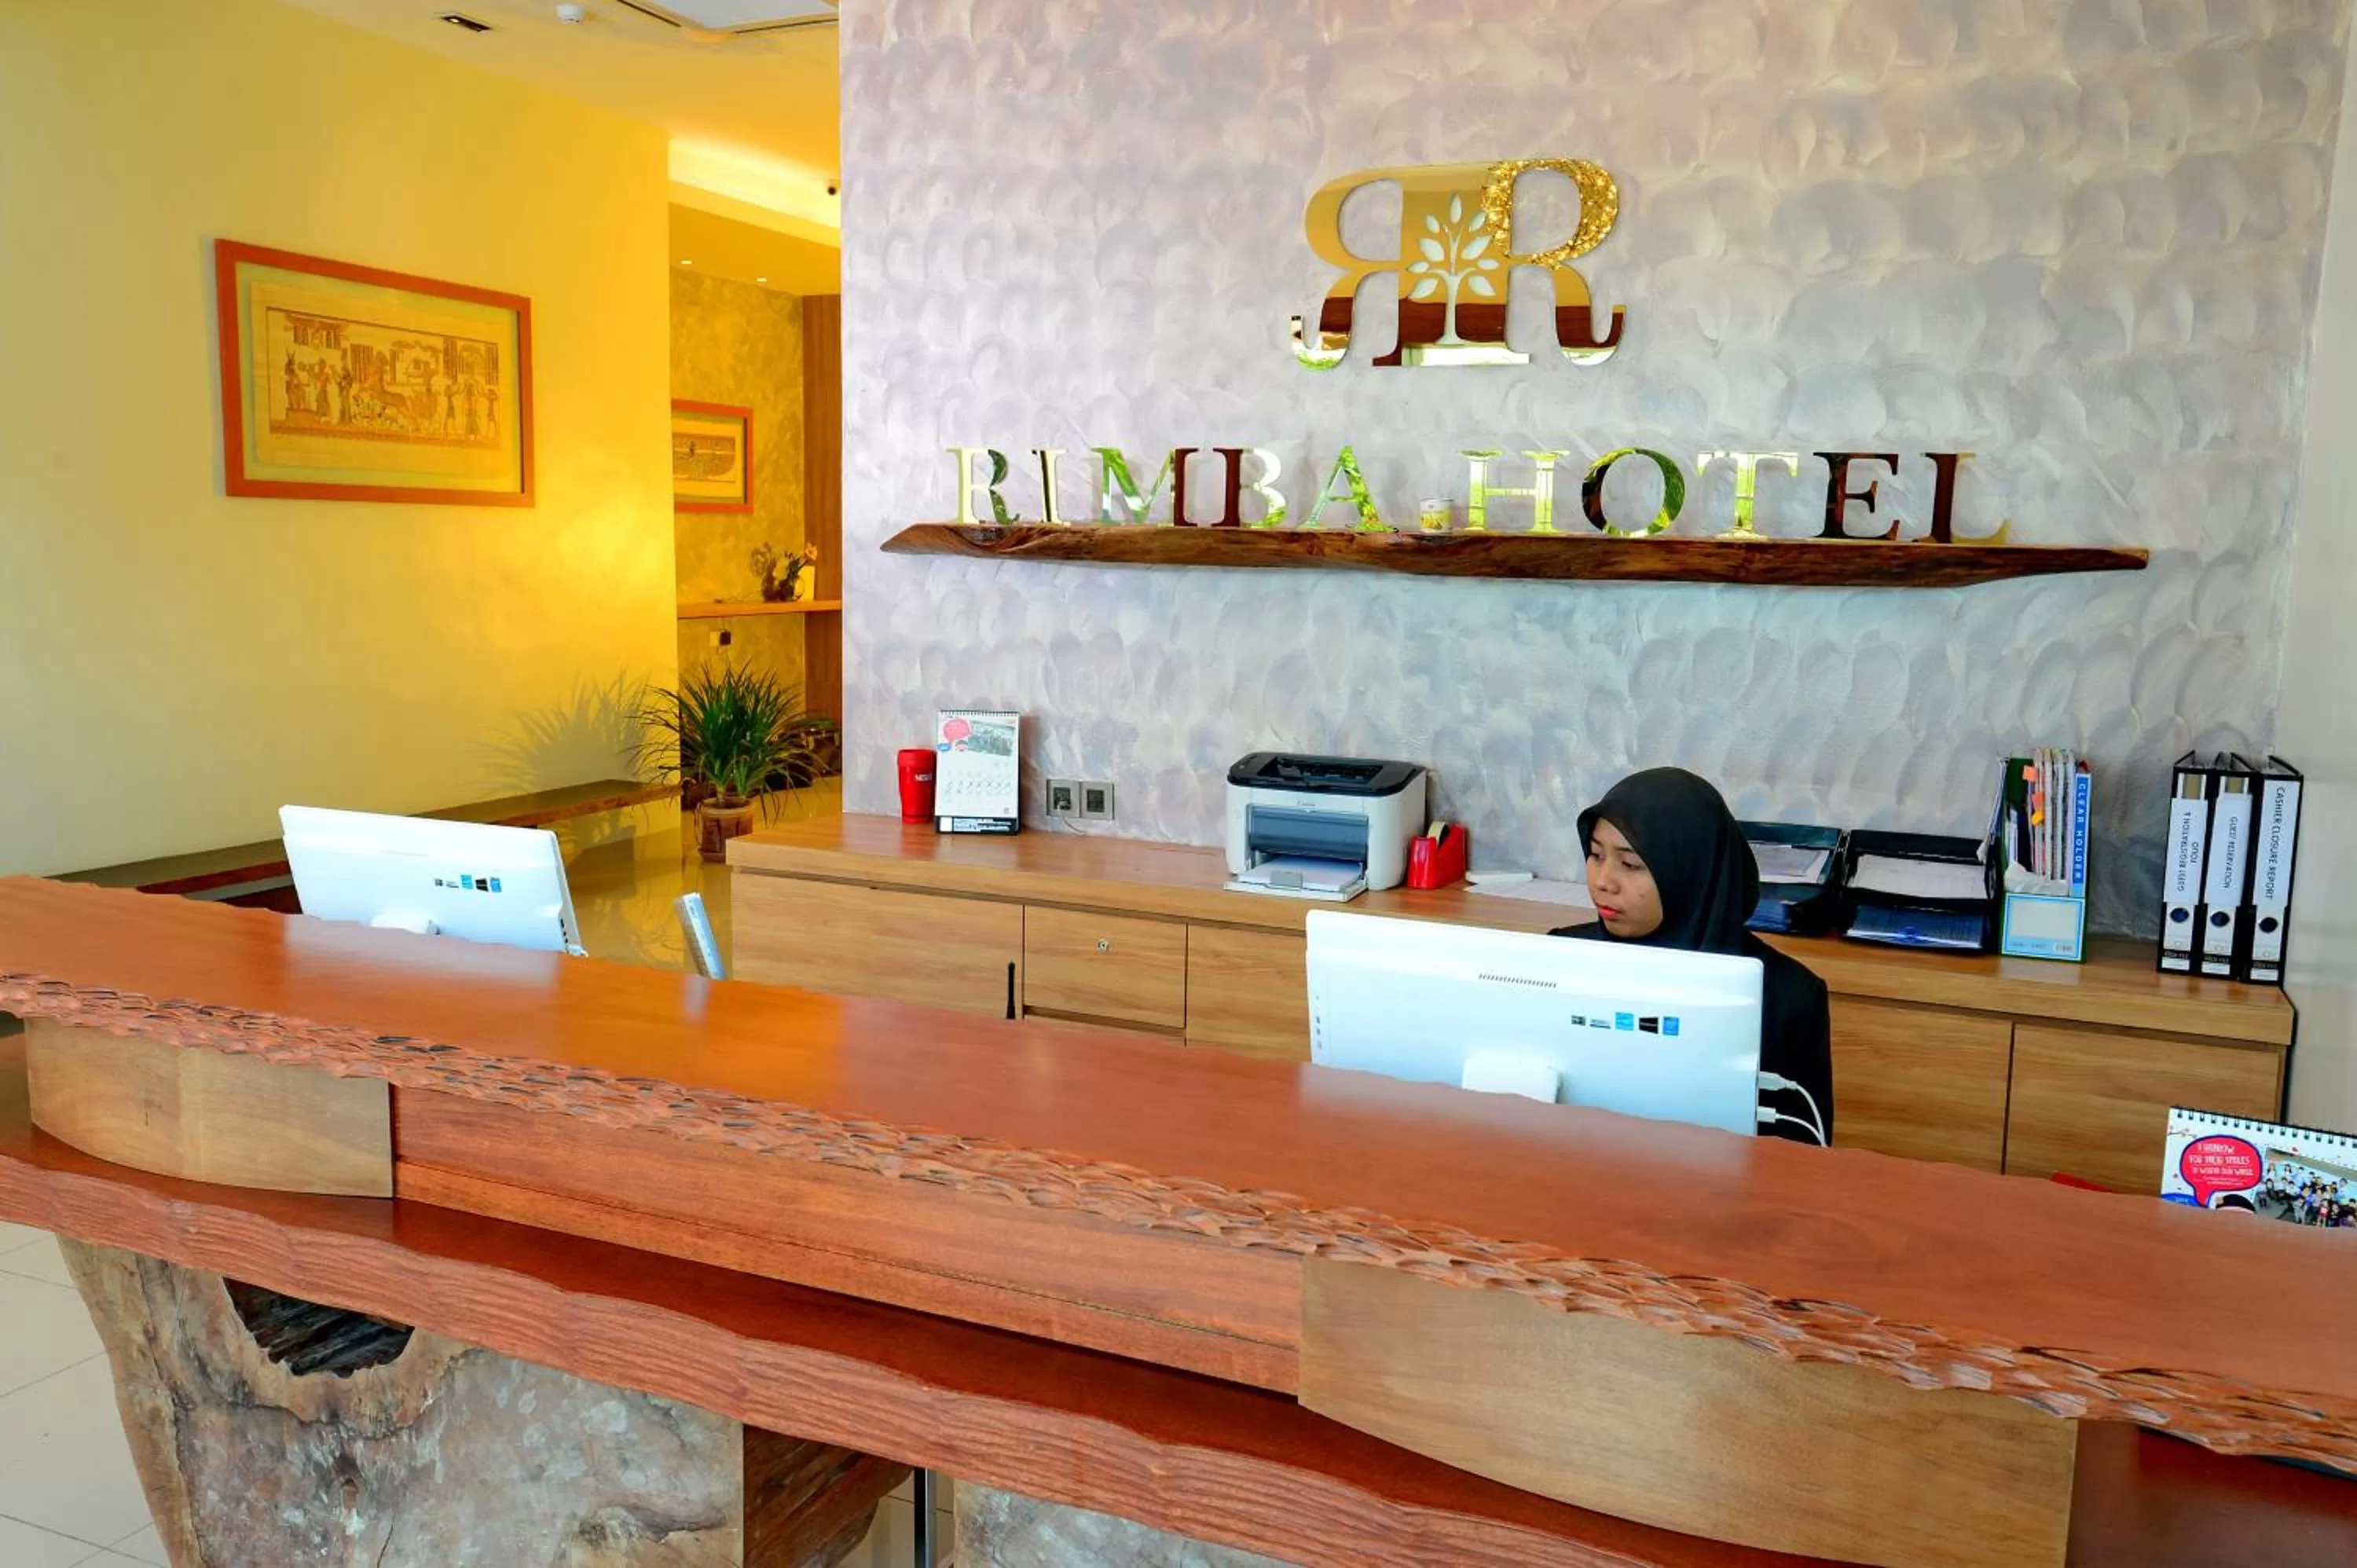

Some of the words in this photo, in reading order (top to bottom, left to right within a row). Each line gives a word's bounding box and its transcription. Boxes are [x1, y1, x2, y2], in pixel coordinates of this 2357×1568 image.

[946, 445, 1395, 533] RIMBA
[1455, 447, 2012, 545] HOTEL
[2077, 782, 2087, 823] CLEAR
[2273, 786, 2285, 824] CASHIER
[2074, 830, 2084, 880] HOLDER
[2269, 825, 2281, 864] CLOSURE
[2265, 866, 2277, 900] REPORT
